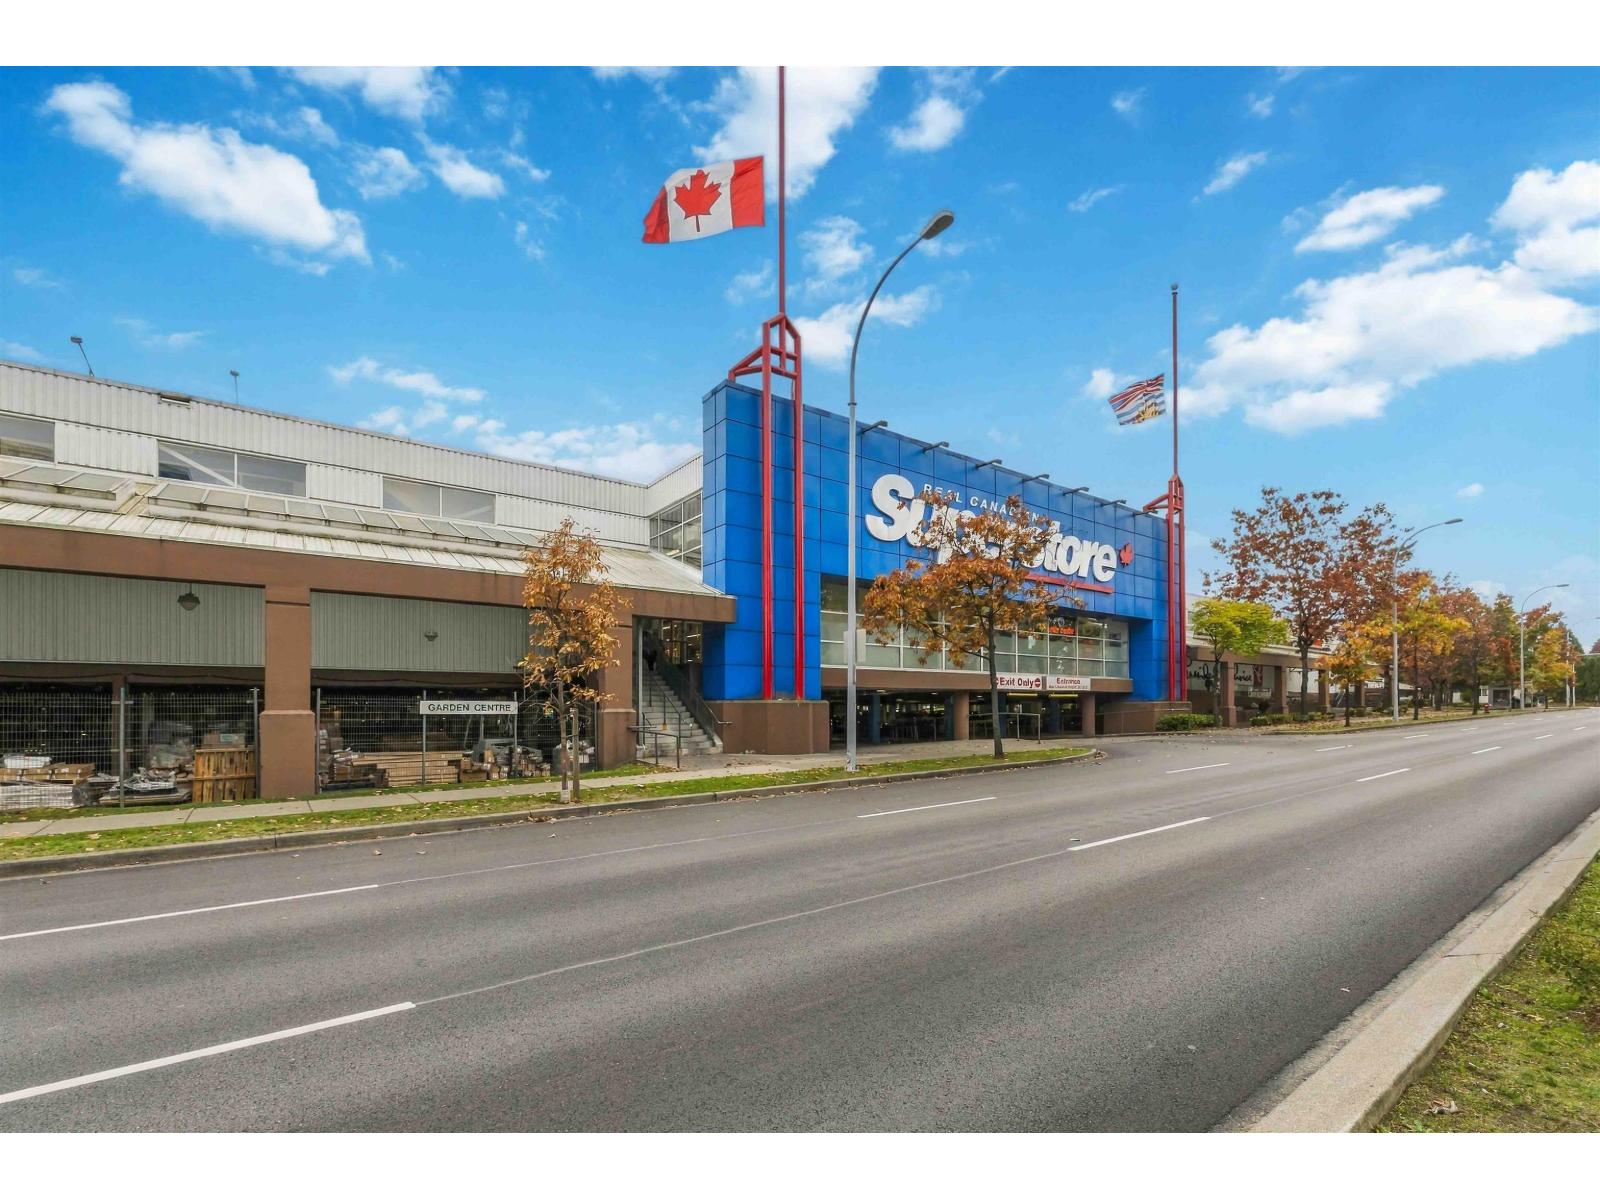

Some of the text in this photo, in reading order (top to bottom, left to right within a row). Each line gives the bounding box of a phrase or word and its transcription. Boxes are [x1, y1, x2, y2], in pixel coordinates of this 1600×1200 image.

[970, 496, 1040, 523] CANADN
[1000, 676, 1034, 688] Exit Only
[428, 703, 511, 712] GARDEN CENTRE
